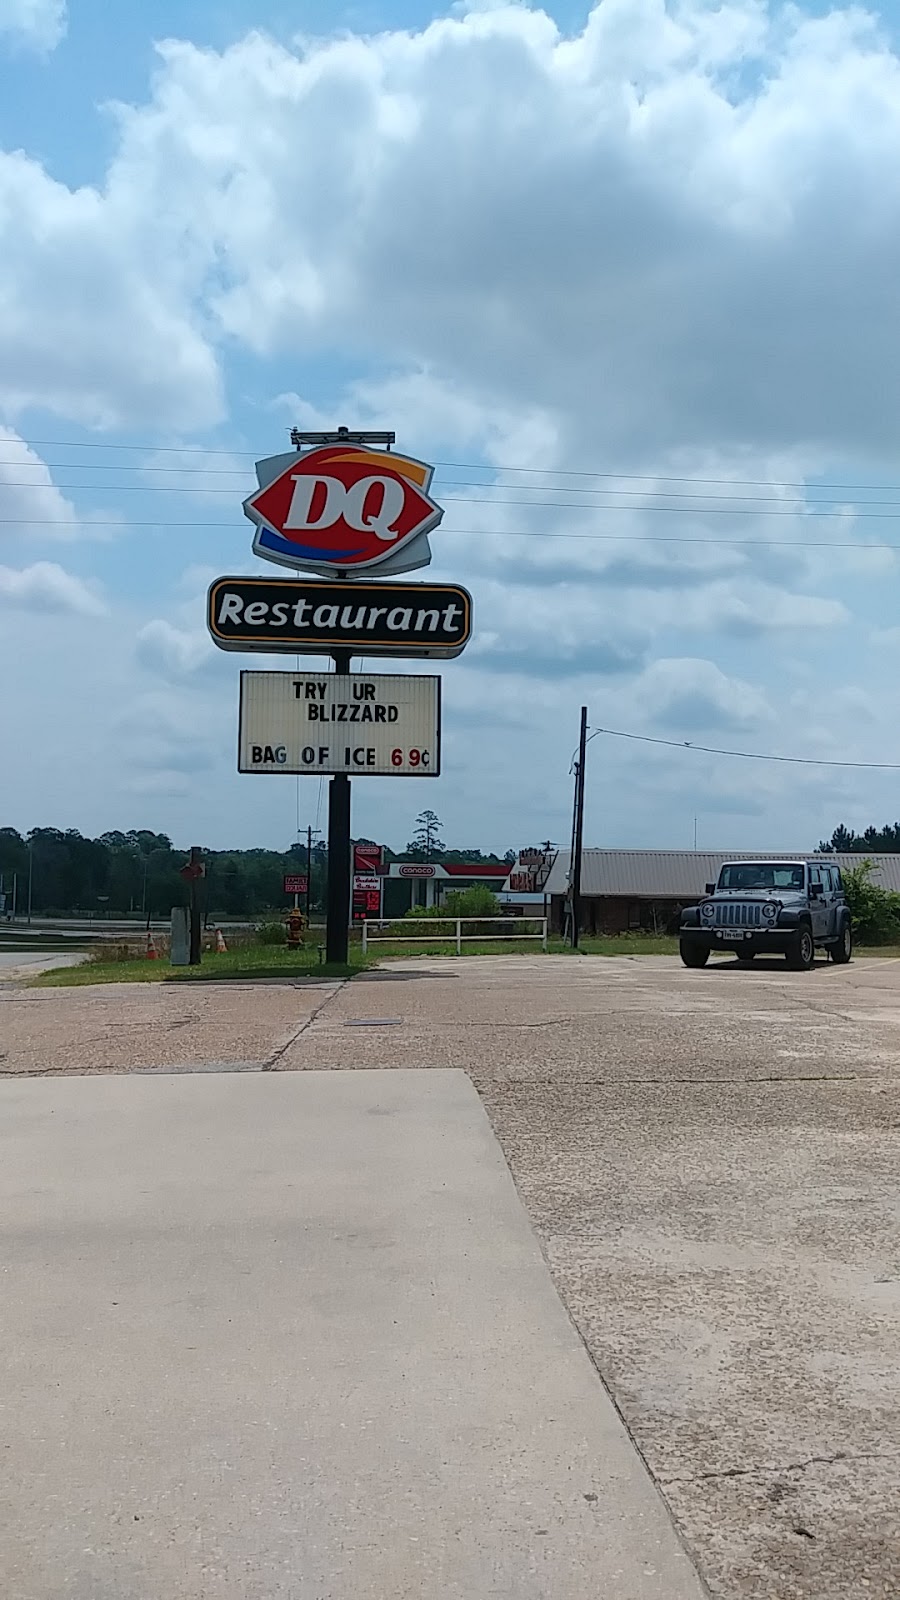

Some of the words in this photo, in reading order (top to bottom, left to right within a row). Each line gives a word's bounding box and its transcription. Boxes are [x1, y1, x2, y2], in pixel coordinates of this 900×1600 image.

[282, 474, 405, 541] DQ
[218, 593, 463, 632] Restaurant
[293, 681, 327, 700] TRY
[352, 683, 376, 701] UR
[308, 704, 399, 723] BLIZZARD
[252, 746, 287, 764] BAG
[302, 747, 329, 765] OF
[345, 747, 376, 766] ICE
